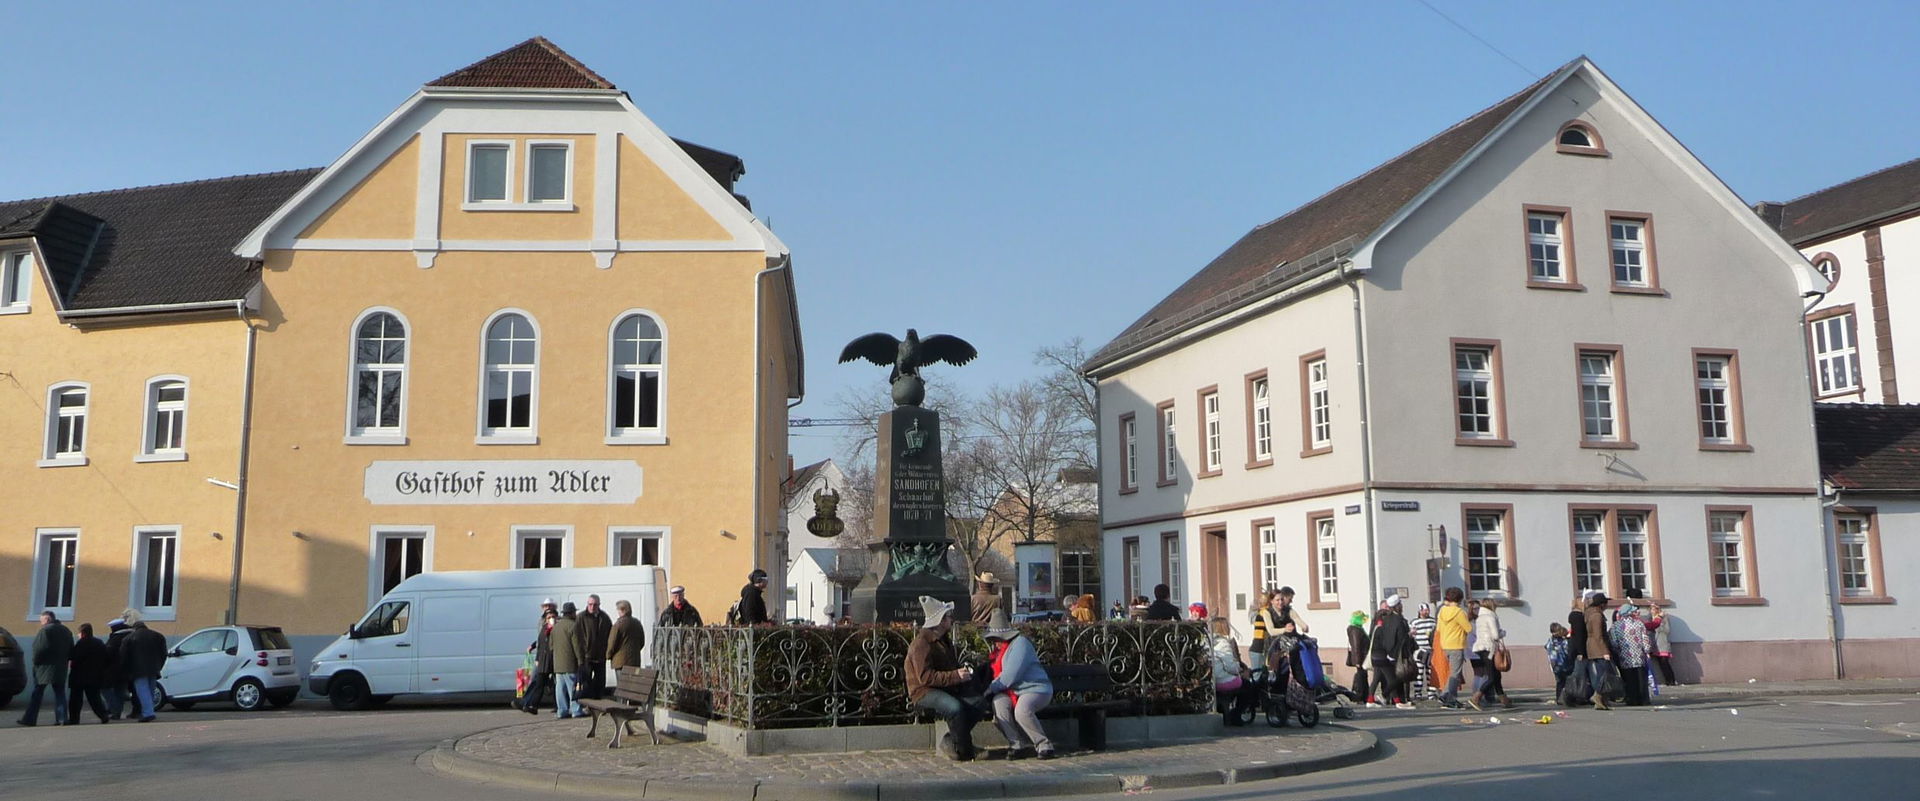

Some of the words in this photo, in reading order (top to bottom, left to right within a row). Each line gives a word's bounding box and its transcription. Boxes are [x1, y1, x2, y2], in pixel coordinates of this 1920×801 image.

[395, 471, 486, 497] Gasthof
[494, 475, 539, 497] zum
[548, 470, 611, 494] Adler
[894, 479, 940, 491] SANDHOFEN
[810, 522, 844, 531] ADLER
